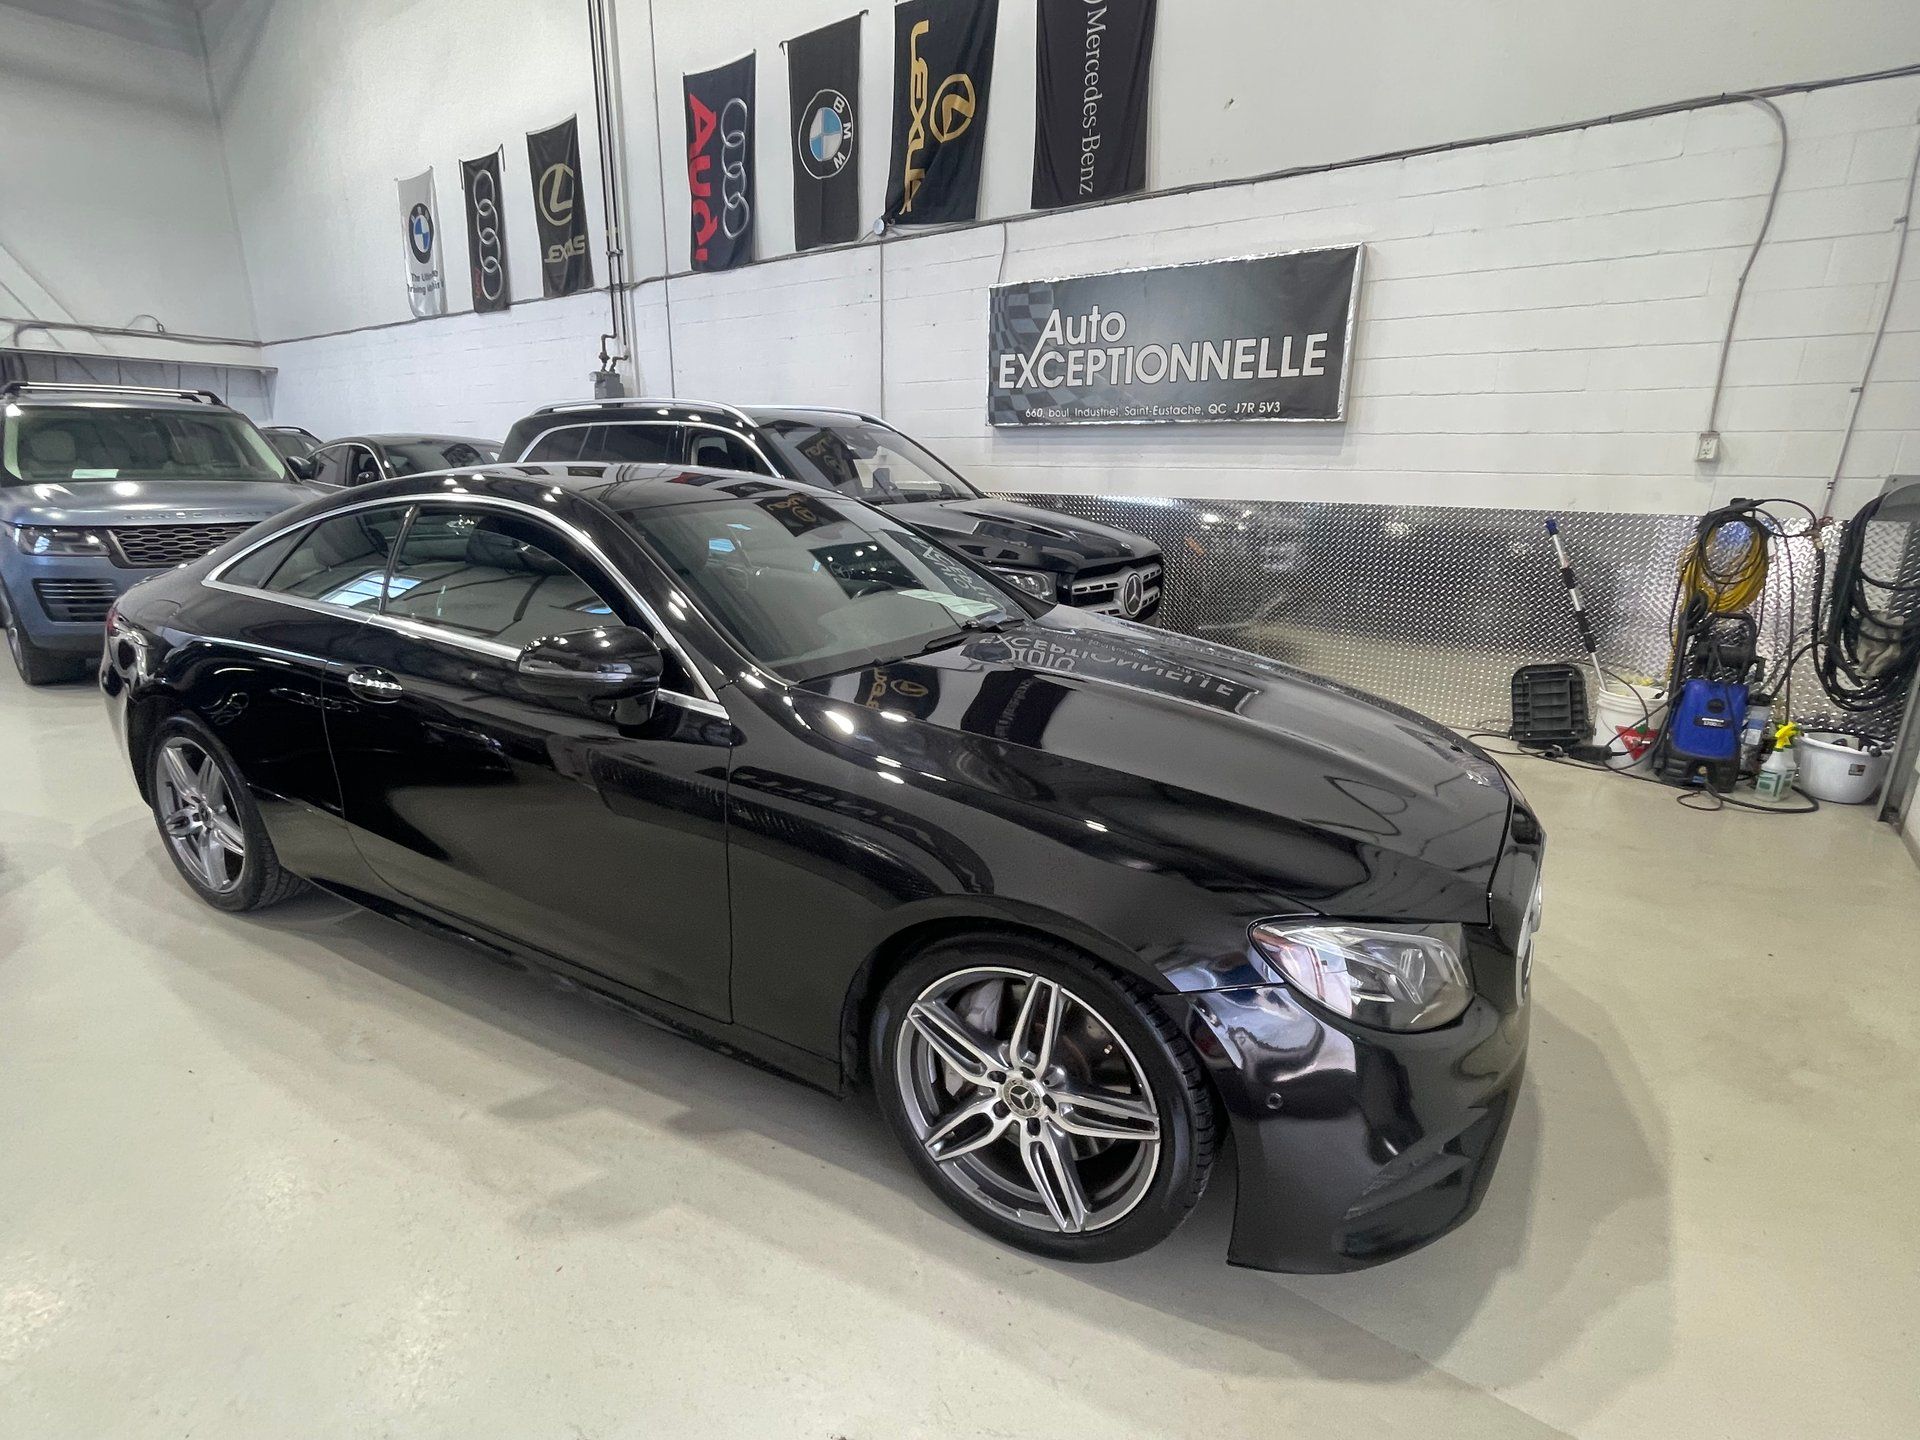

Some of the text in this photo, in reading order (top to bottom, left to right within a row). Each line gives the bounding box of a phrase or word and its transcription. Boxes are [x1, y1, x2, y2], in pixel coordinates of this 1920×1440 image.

[1078, 5, 1108, 195] Mercedes-Benz
[833, 96, 852, 170] BMW
[1036, 305, 1127, 347] Auto
[999, 332, 1329, 390] EXCEPTIONNELLE
[1208, 402, 1227, 414] QC
[1234, 402, 1255, 414] J7R
[1258, 401, 1281, 413] 5V3
